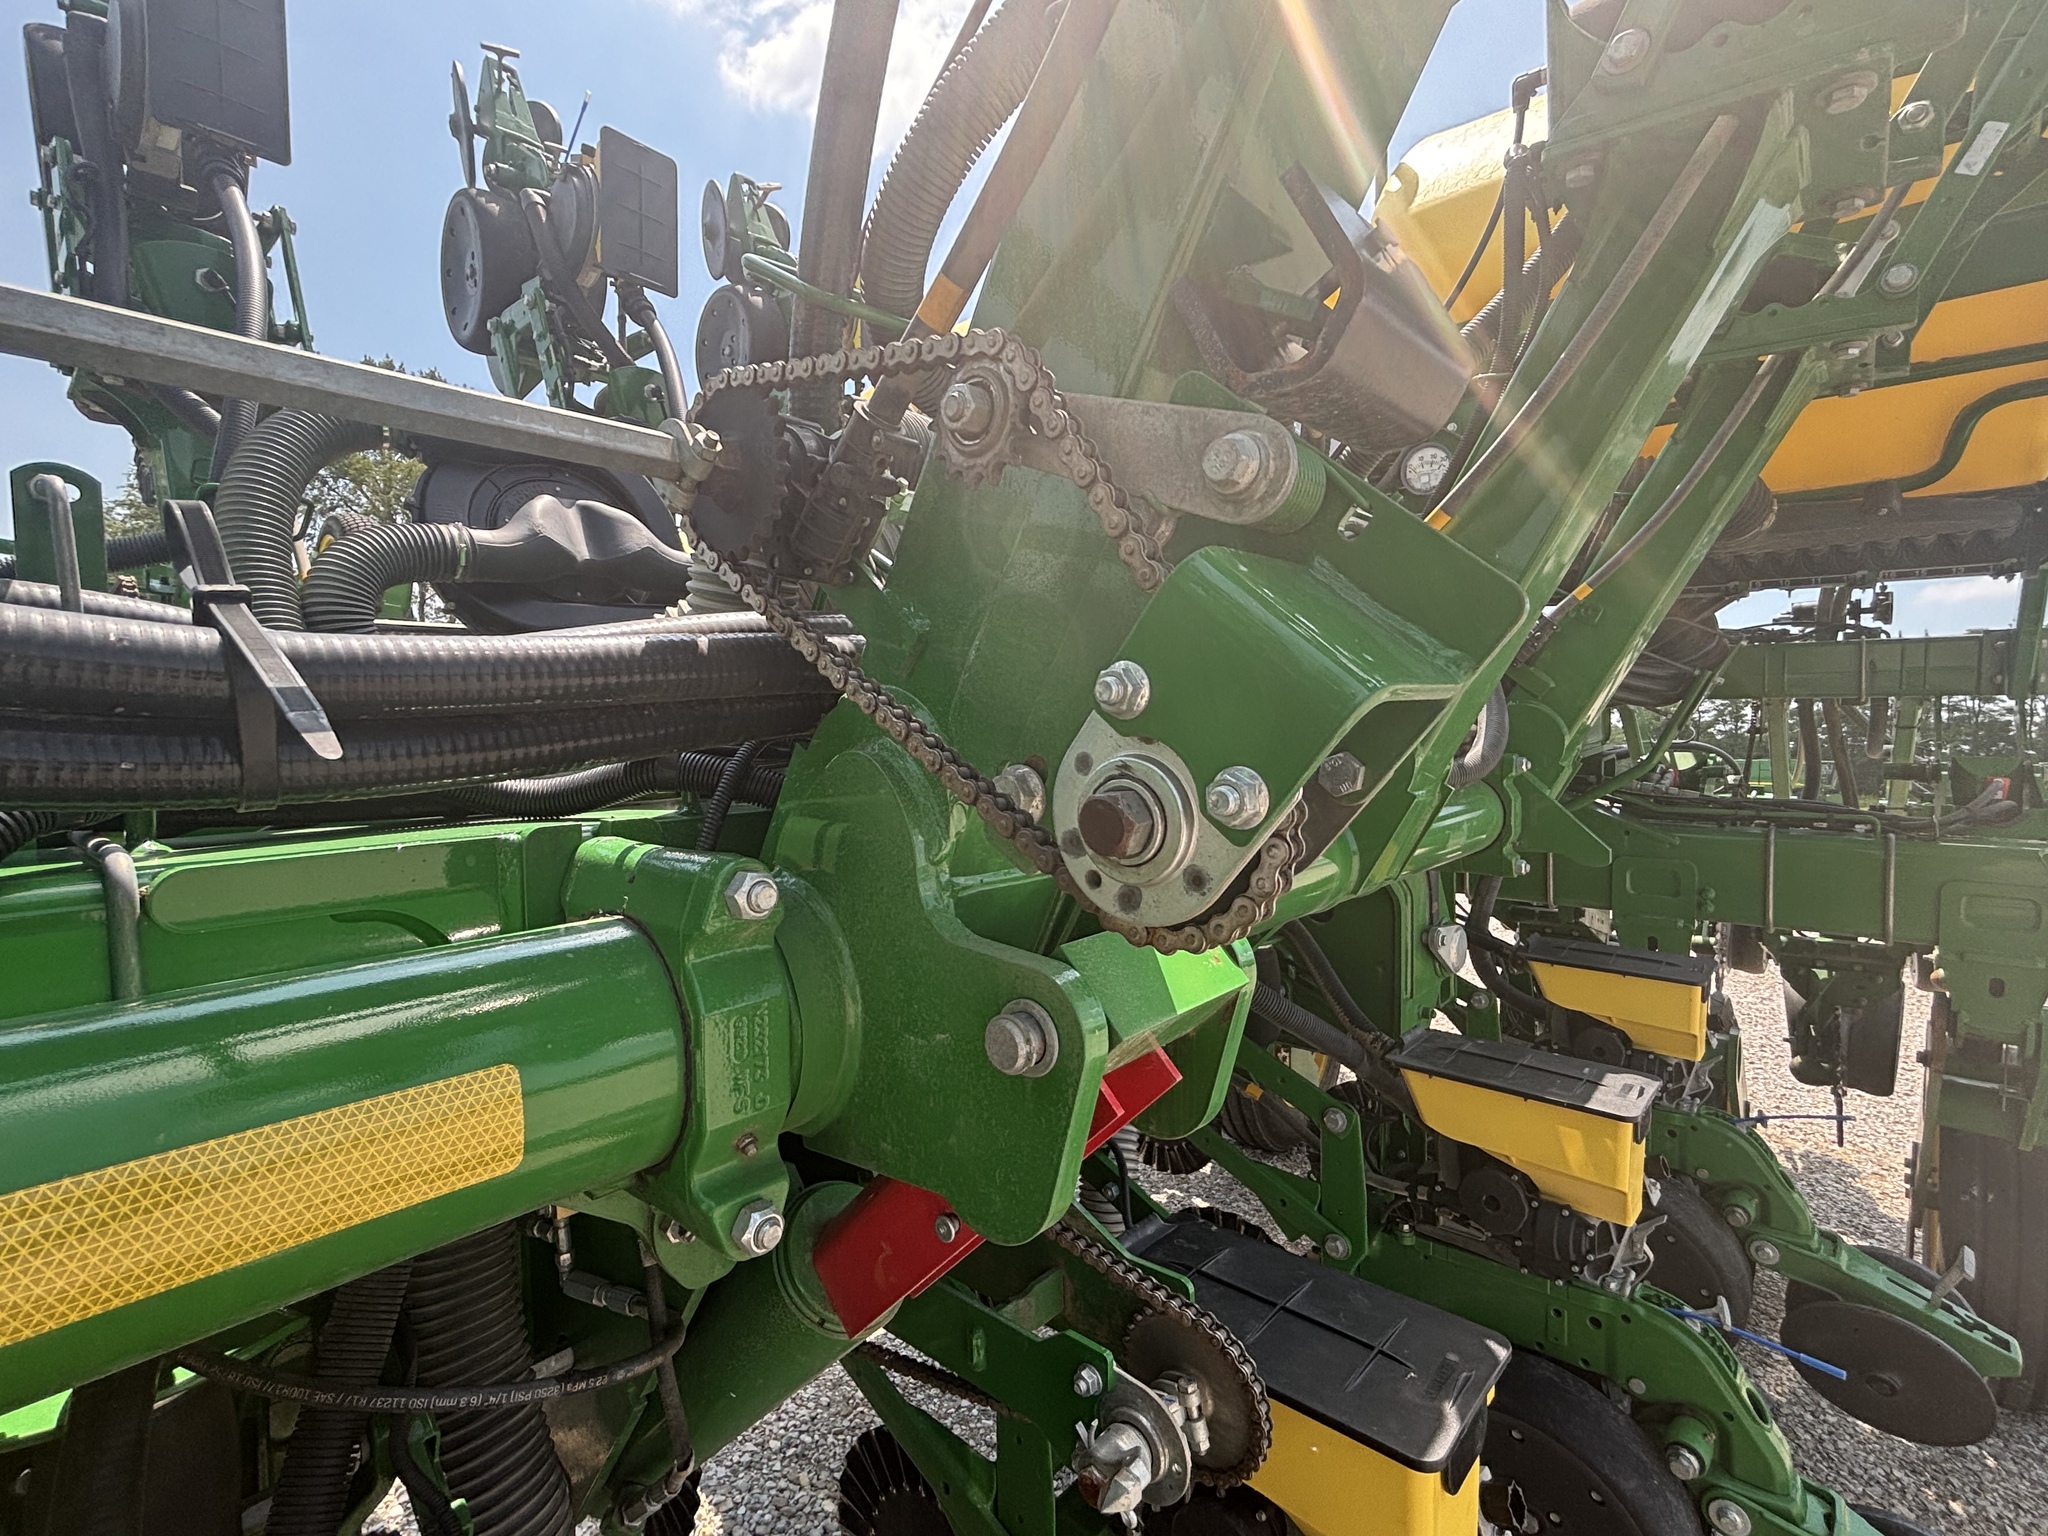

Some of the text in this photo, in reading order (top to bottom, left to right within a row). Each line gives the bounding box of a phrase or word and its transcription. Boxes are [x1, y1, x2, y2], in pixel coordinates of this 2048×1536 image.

[567, 1379, 588, 1393] MPa
[313, 1391, 336, 1405] SAE
[369, 1397, 407, 1409] 11237
[408, 1398, 429, 1410] ISO
